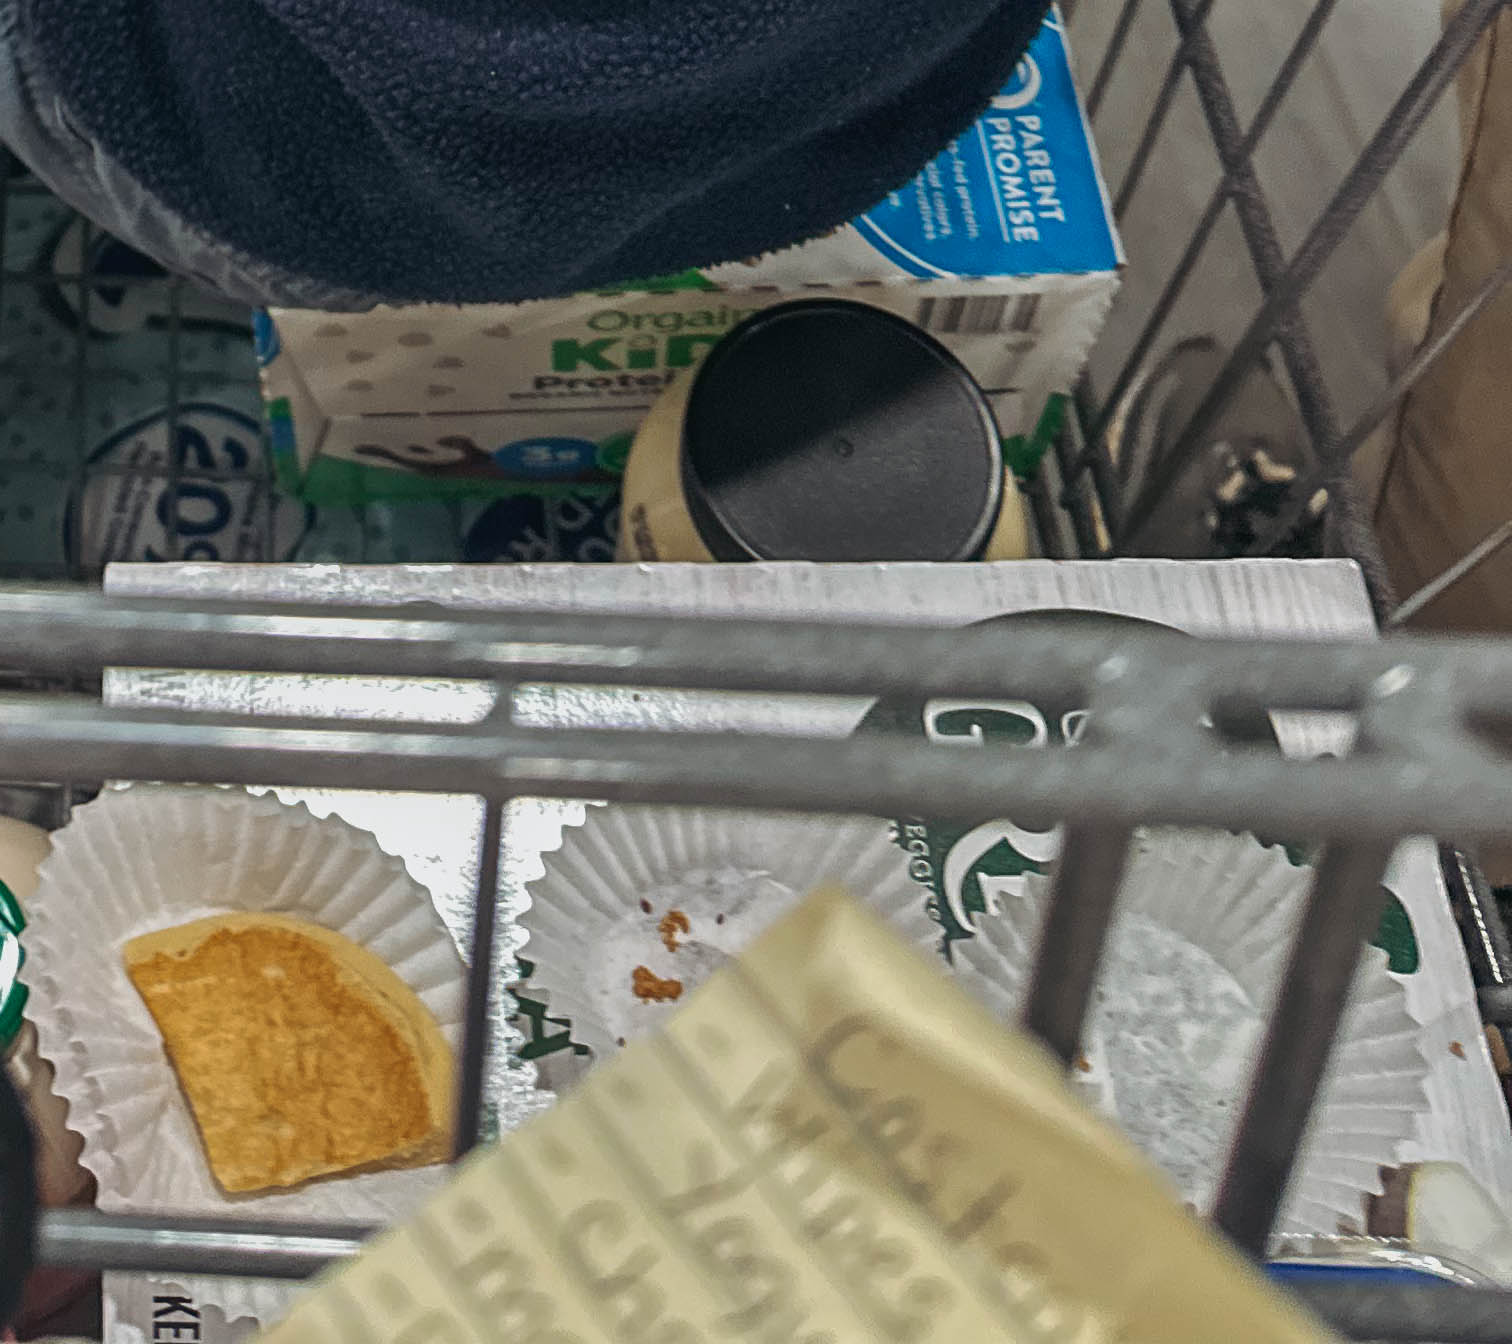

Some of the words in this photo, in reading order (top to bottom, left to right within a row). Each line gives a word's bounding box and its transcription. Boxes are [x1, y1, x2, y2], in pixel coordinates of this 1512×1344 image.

[984, 116, 1041, 243] PROMISE
[1014, 114, 1067, 223] PARENT
[151, 1295, 201, 1344] KE
